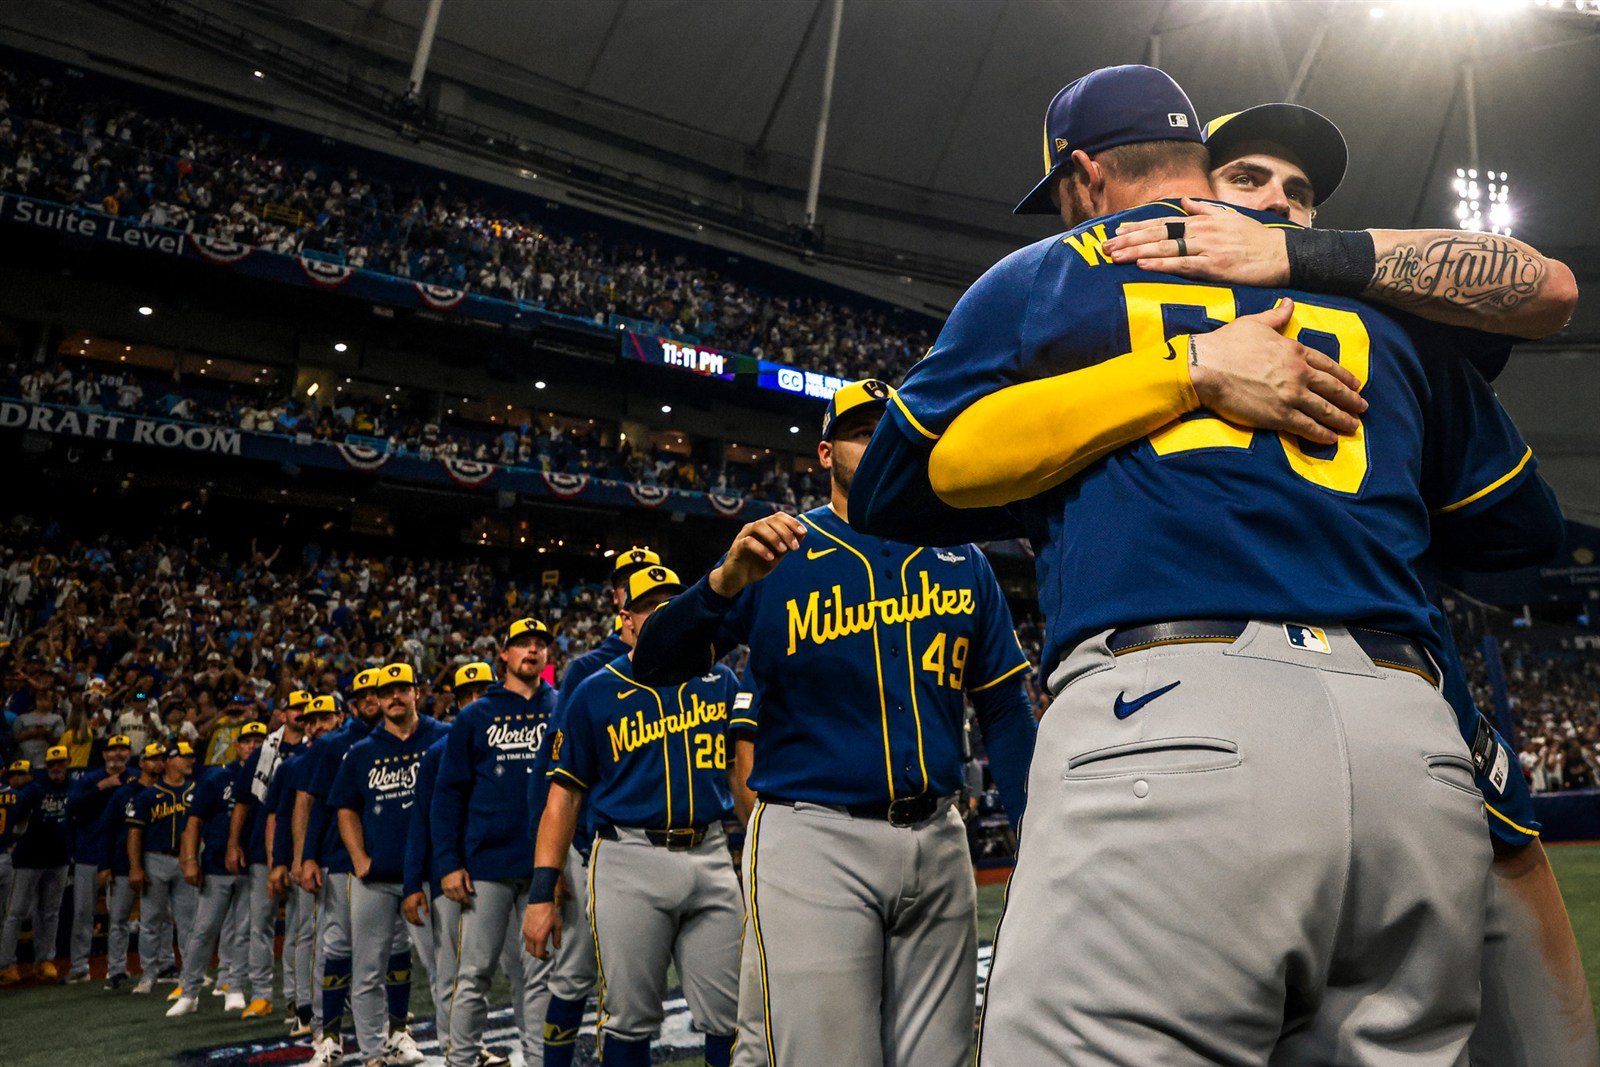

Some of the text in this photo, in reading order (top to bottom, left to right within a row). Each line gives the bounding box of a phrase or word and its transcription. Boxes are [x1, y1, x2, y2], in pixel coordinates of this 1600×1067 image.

[13, 200, 97, 236] Suite
[106, 220, 184, 255] Level
[1063, 223, 1113, 267] W
[1385, 246, 1422, 279] the
[1418, 237, 1533, 298] Faith
[661, 342, 724, 375] 11:11 PM
[780, 372, 801, 389] CC
[0, 402, 242, 456] DRAFT ROOM
[786, 570, 976, 657] Milwaukee
[921, 632, 970, 691] 49
[606, 693, 728, 763] Milwaukee
[693, 732, 727, 771] 28
